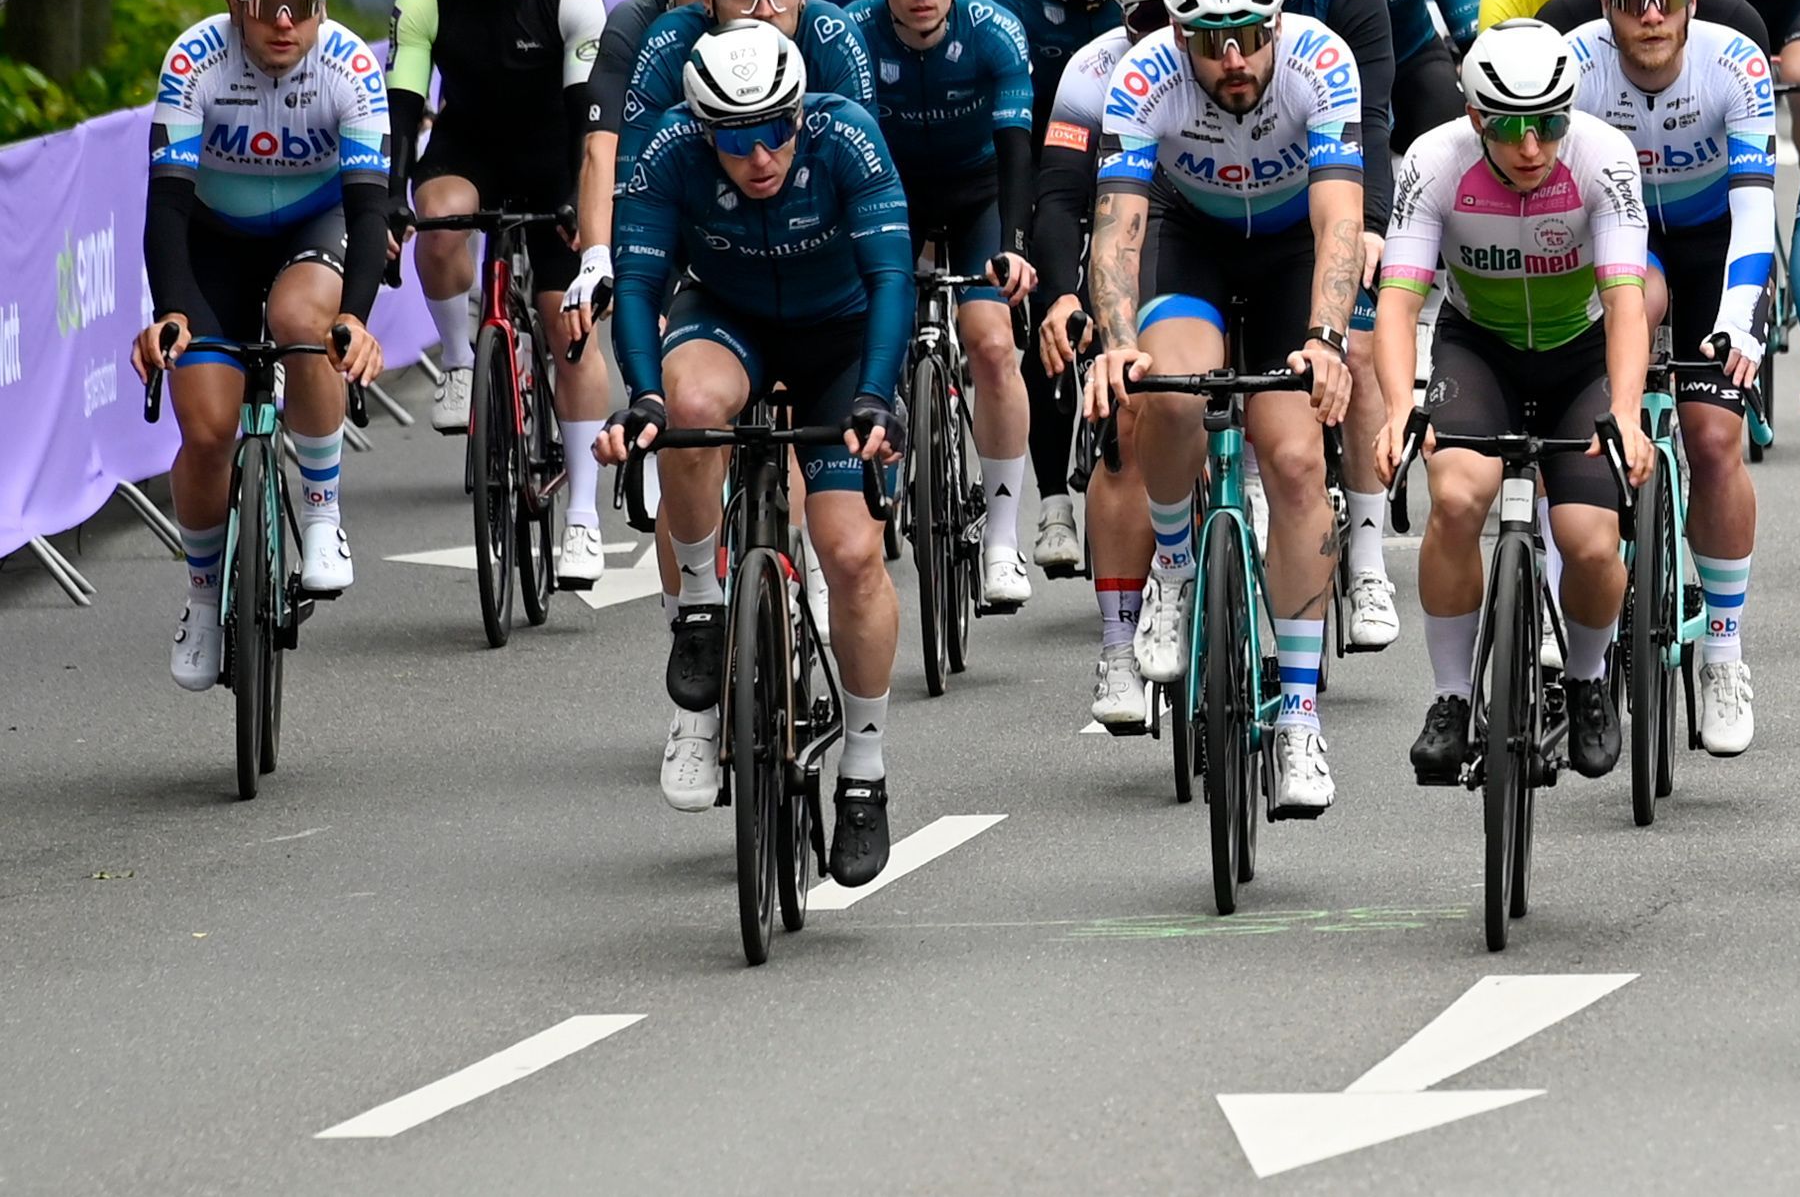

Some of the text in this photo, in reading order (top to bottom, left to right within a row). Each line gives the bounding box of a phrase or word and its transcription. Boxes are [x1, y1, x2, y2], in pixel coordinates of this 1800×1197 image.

[158, 24, 225, 106] Mobil
[323, 30, 388, 113] Mobil
[631, 29, 678, 85] well:fair
[730, 47, 757, 61] 873
[844, 31, 873, 103] well:fair
[1106, 43, 1179, 120] Mobil
[1292, 29, 1358, 109] Mobil
[1723, 36, 1775, 118] Mobil
[205, 146, 338, 168] KRANKENKASSE
[207, 123, 337, 160] Mobil
[833, 120, 882, 176] well:fair
[1175, 142, 1308, 182] Mobil
[1681, 381, 1718, 395] LAWI
